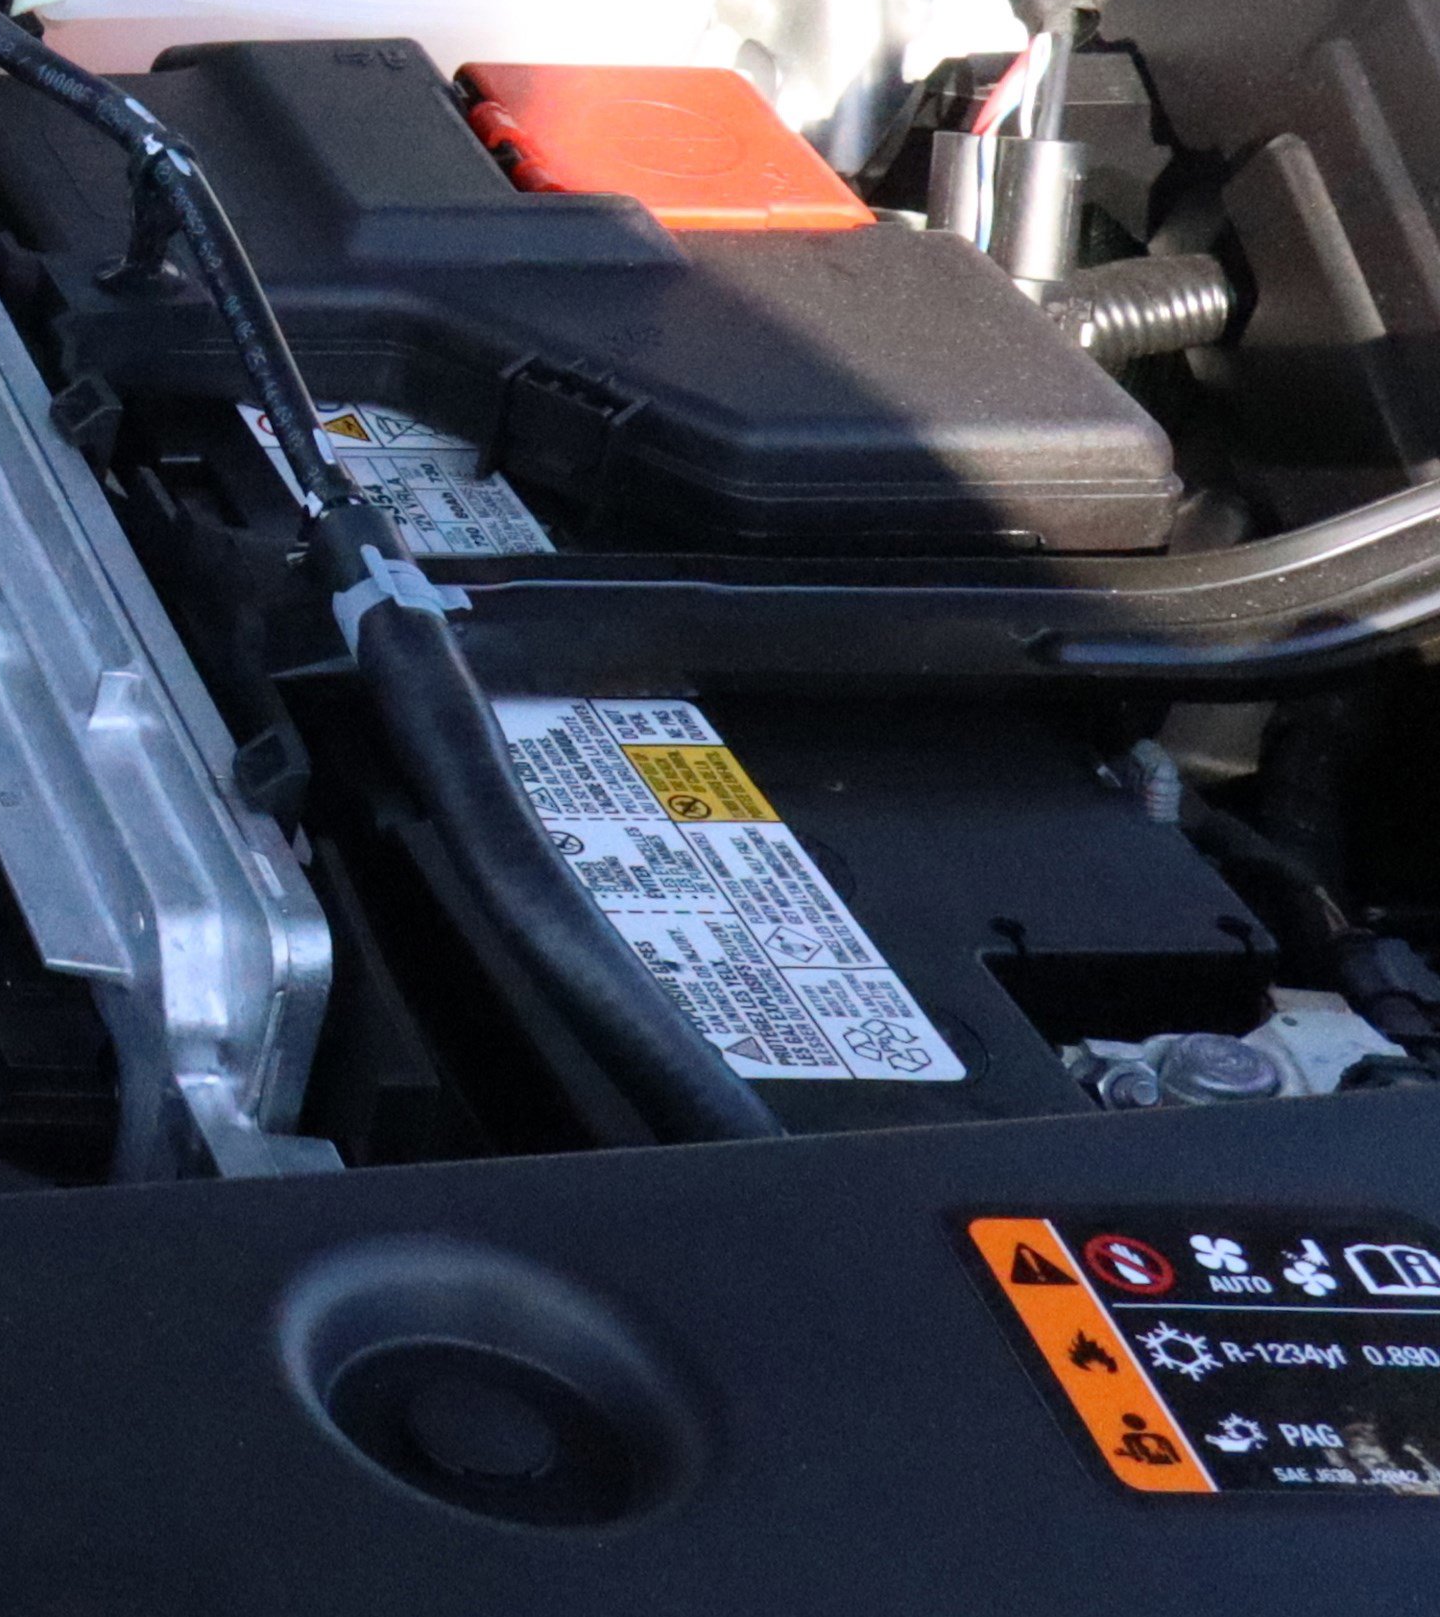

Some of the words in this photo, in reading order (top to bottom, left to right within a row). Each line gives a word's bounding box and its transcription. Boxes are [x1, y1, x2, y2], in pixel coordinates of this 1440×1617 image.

[702, 920, 746, 961] PEUVENT
[681, 981, 717, 1011] CAUSE
[732, 964, 786, 1019] EXPLOSIFS
[754, 967, 795, 1004] RENDRE
[700, 981, 752, 1033] BLINDNESS
[729, 990, 758, 1008] LES
[781, 1007, 806, 1020] OU
[772, 1023, 804, 1043] GAZ
[793, 1023, 839, 1065] BLESSER
[873, 1037, 900, 1052] Pb
[789, 1047, 820, 1065] LES
[1209, 1273, 1274, 1296] AUTO
[1220, 1341, 1348, 1369] R-1234yf
[1278, 1422, 1345, 1448] PAG
[1273, 1467, 1313, 1483] SAE
